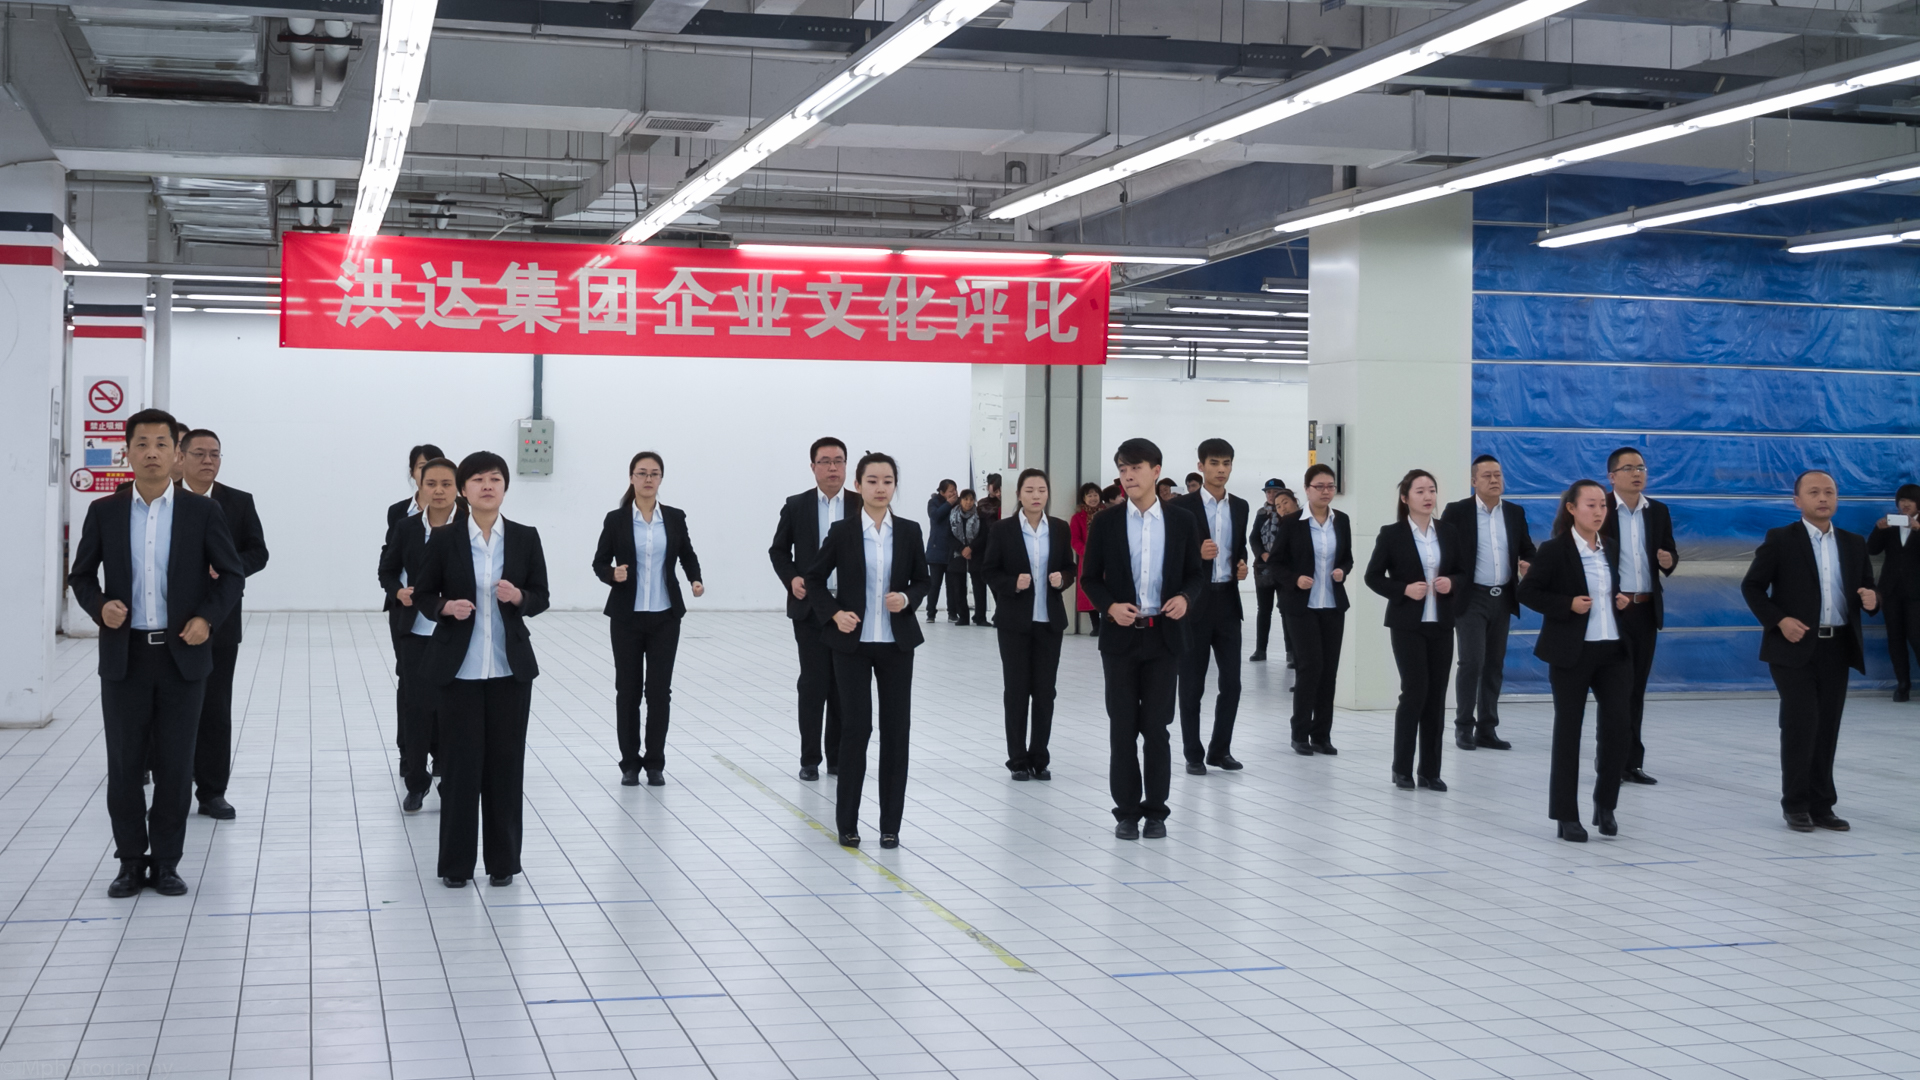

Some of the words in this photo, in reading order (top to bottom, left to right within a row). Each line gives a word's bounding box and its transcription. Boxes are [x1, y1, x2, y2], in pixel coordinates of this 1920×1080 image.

[335, 258, 1079, 344] 洪达集团企业文化评比
[90, 422, 123, 430] 禁止吸烟
